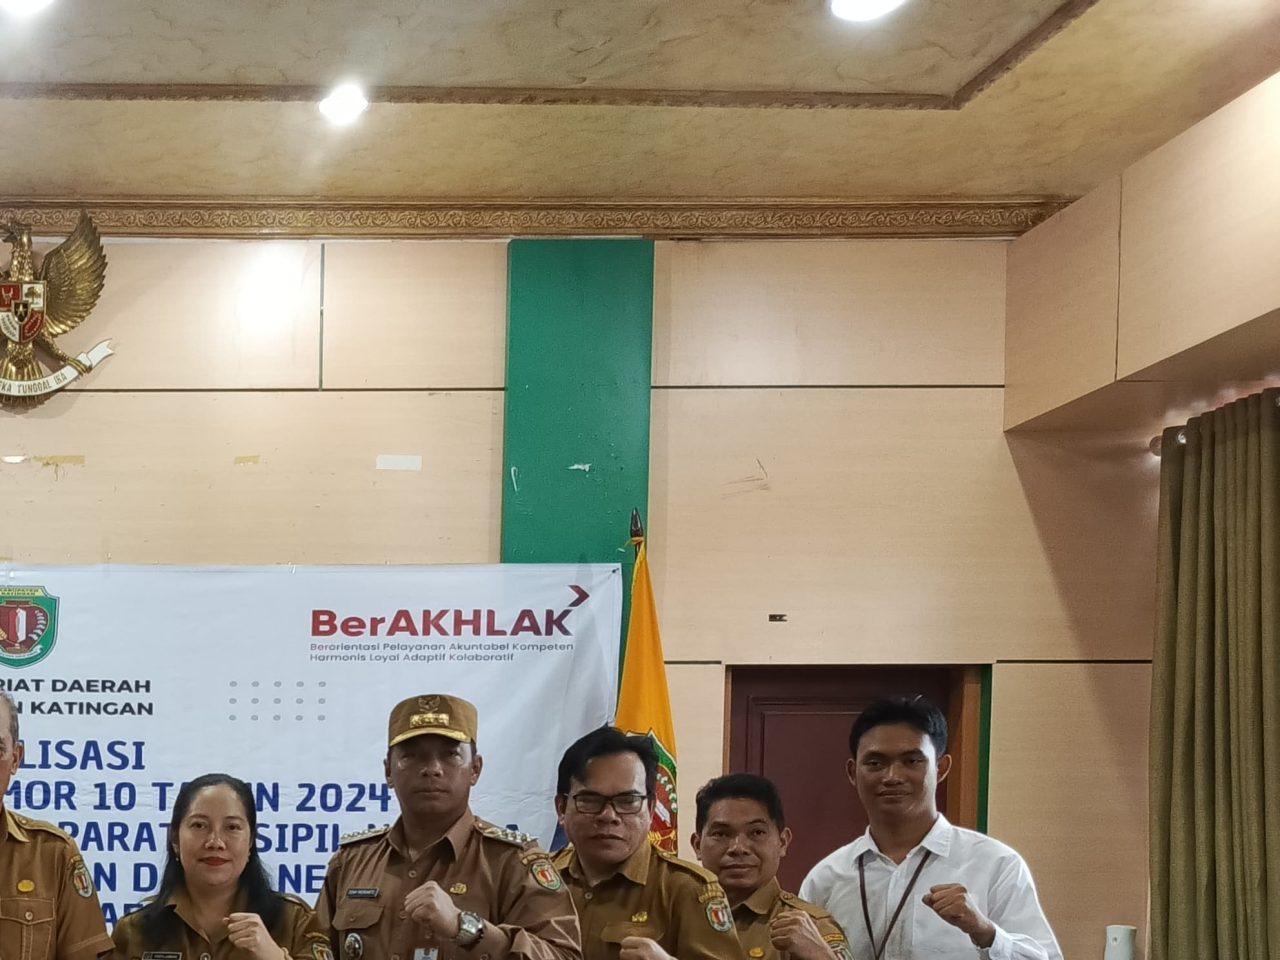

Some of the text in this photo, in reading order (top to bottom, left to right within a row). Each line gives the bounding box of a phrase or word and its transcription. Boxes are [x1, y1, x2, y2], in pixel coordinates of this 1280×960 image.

[17, 381, 52, 394] TUNGGAL
[311, 608, 574, 637] BerAKHLAK
[310, 643, 574, 654] Berorientasi Pelayanan Akuntabel Kompeten
[310, 653, 515, 664] Harmonis Loyal Adaptif Kolaboratif
[51, 679, 151, 693] DAERAH
[30, 701, 154, 716] KATINGAN
[93, 782, 137, 811] 10
[296, 783, 392, 812] 2024
